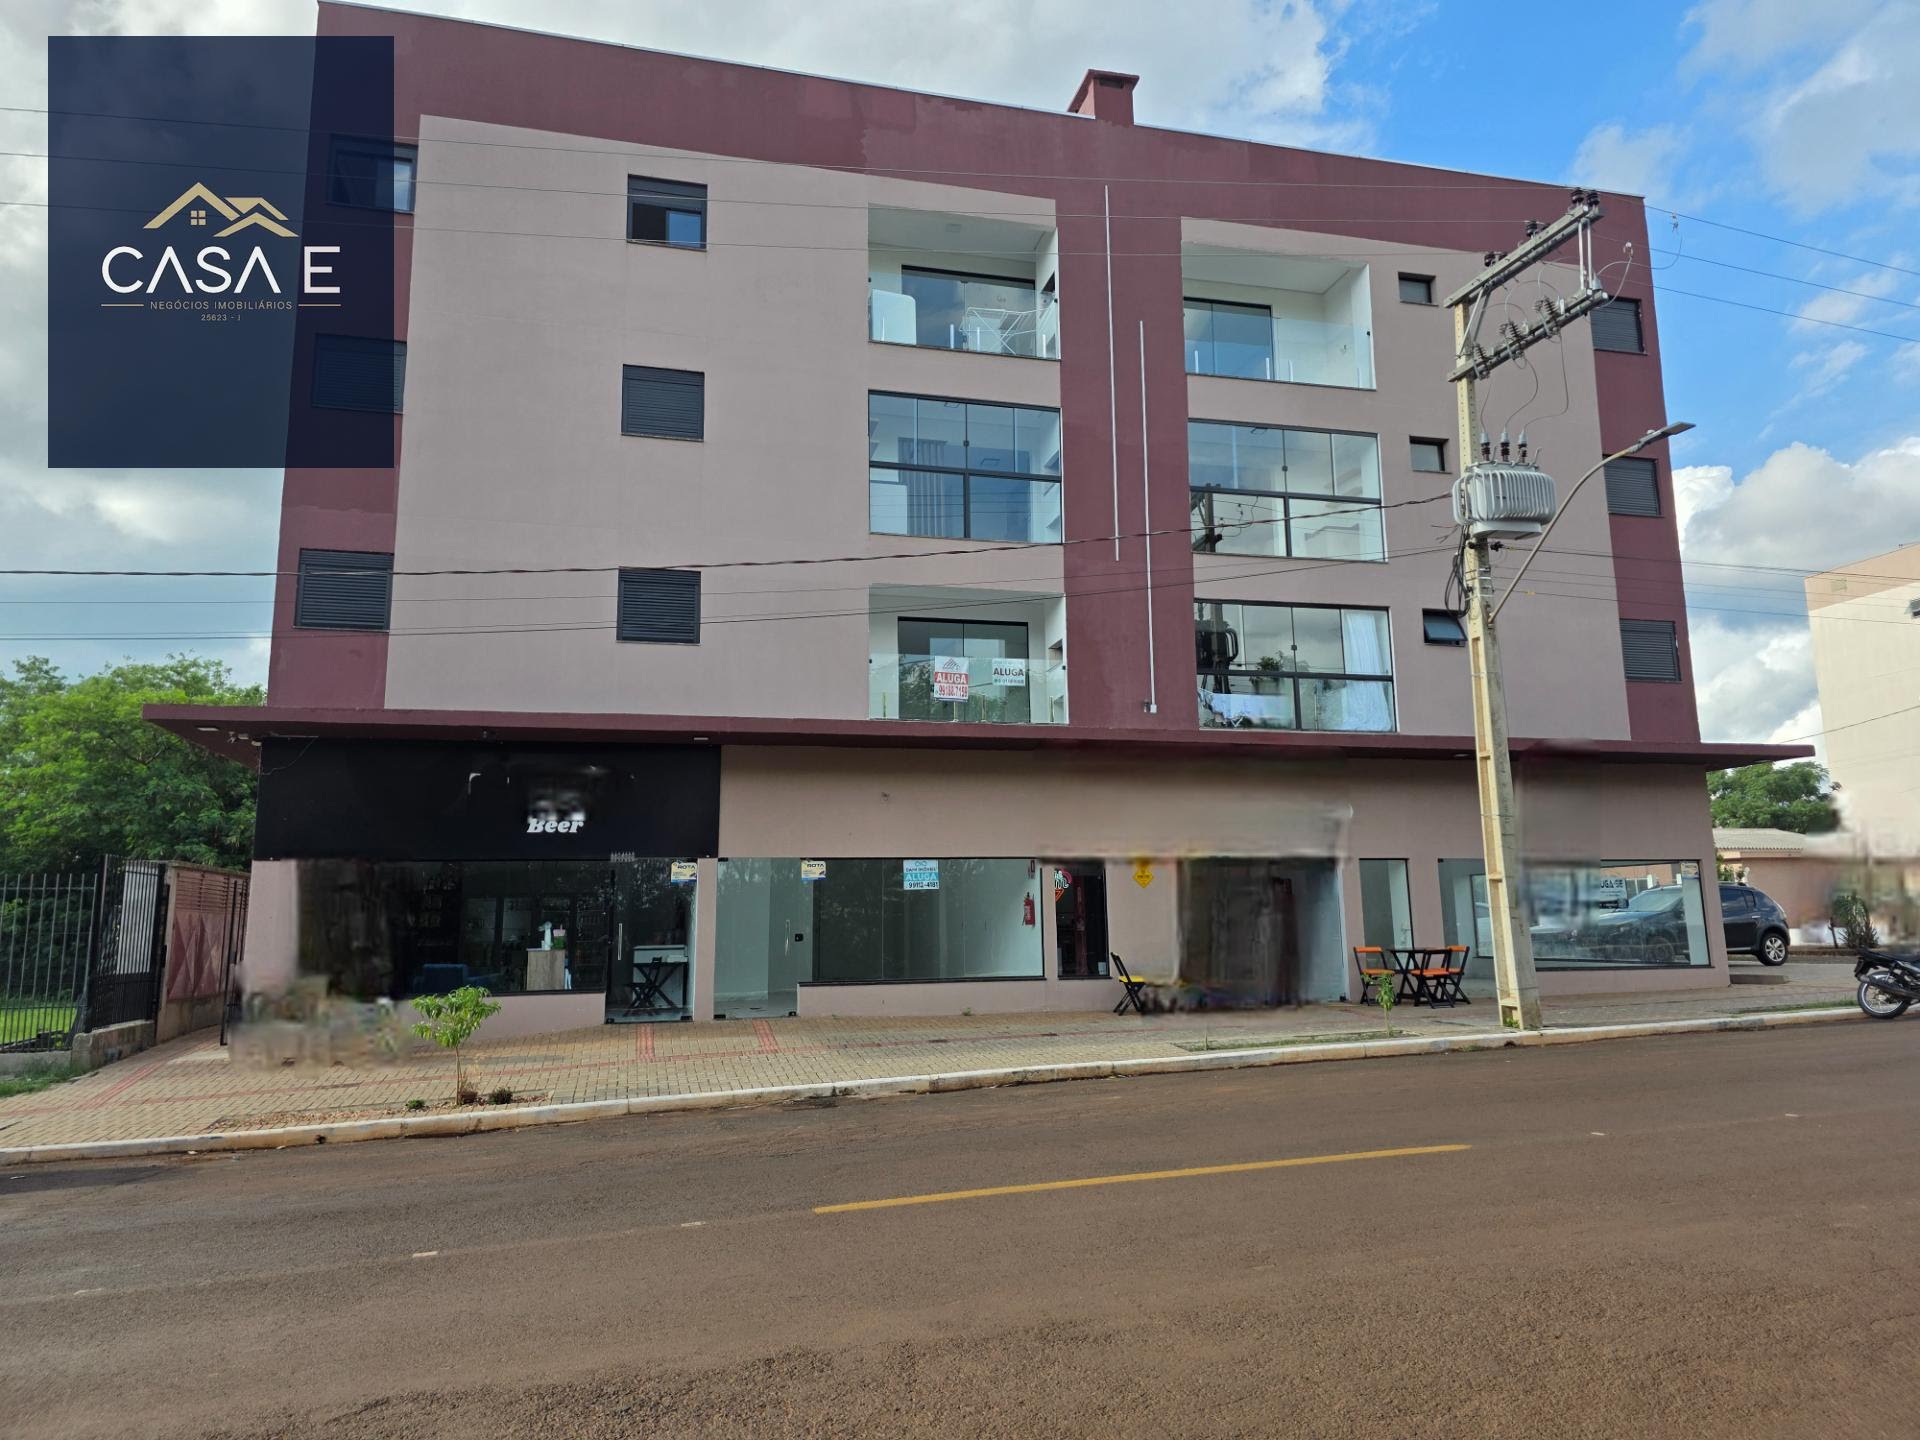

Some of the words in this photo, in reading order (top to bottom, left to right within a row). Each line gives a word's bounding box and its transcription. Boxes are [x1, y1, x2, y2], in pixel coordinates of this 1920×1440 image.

[994, 667, 1024, 676] ALUGA
[936, 673, 966, 684] ALUGA
[527, 818, 584, 833] Beer
[905, 872, 937, 881] ALUGA
